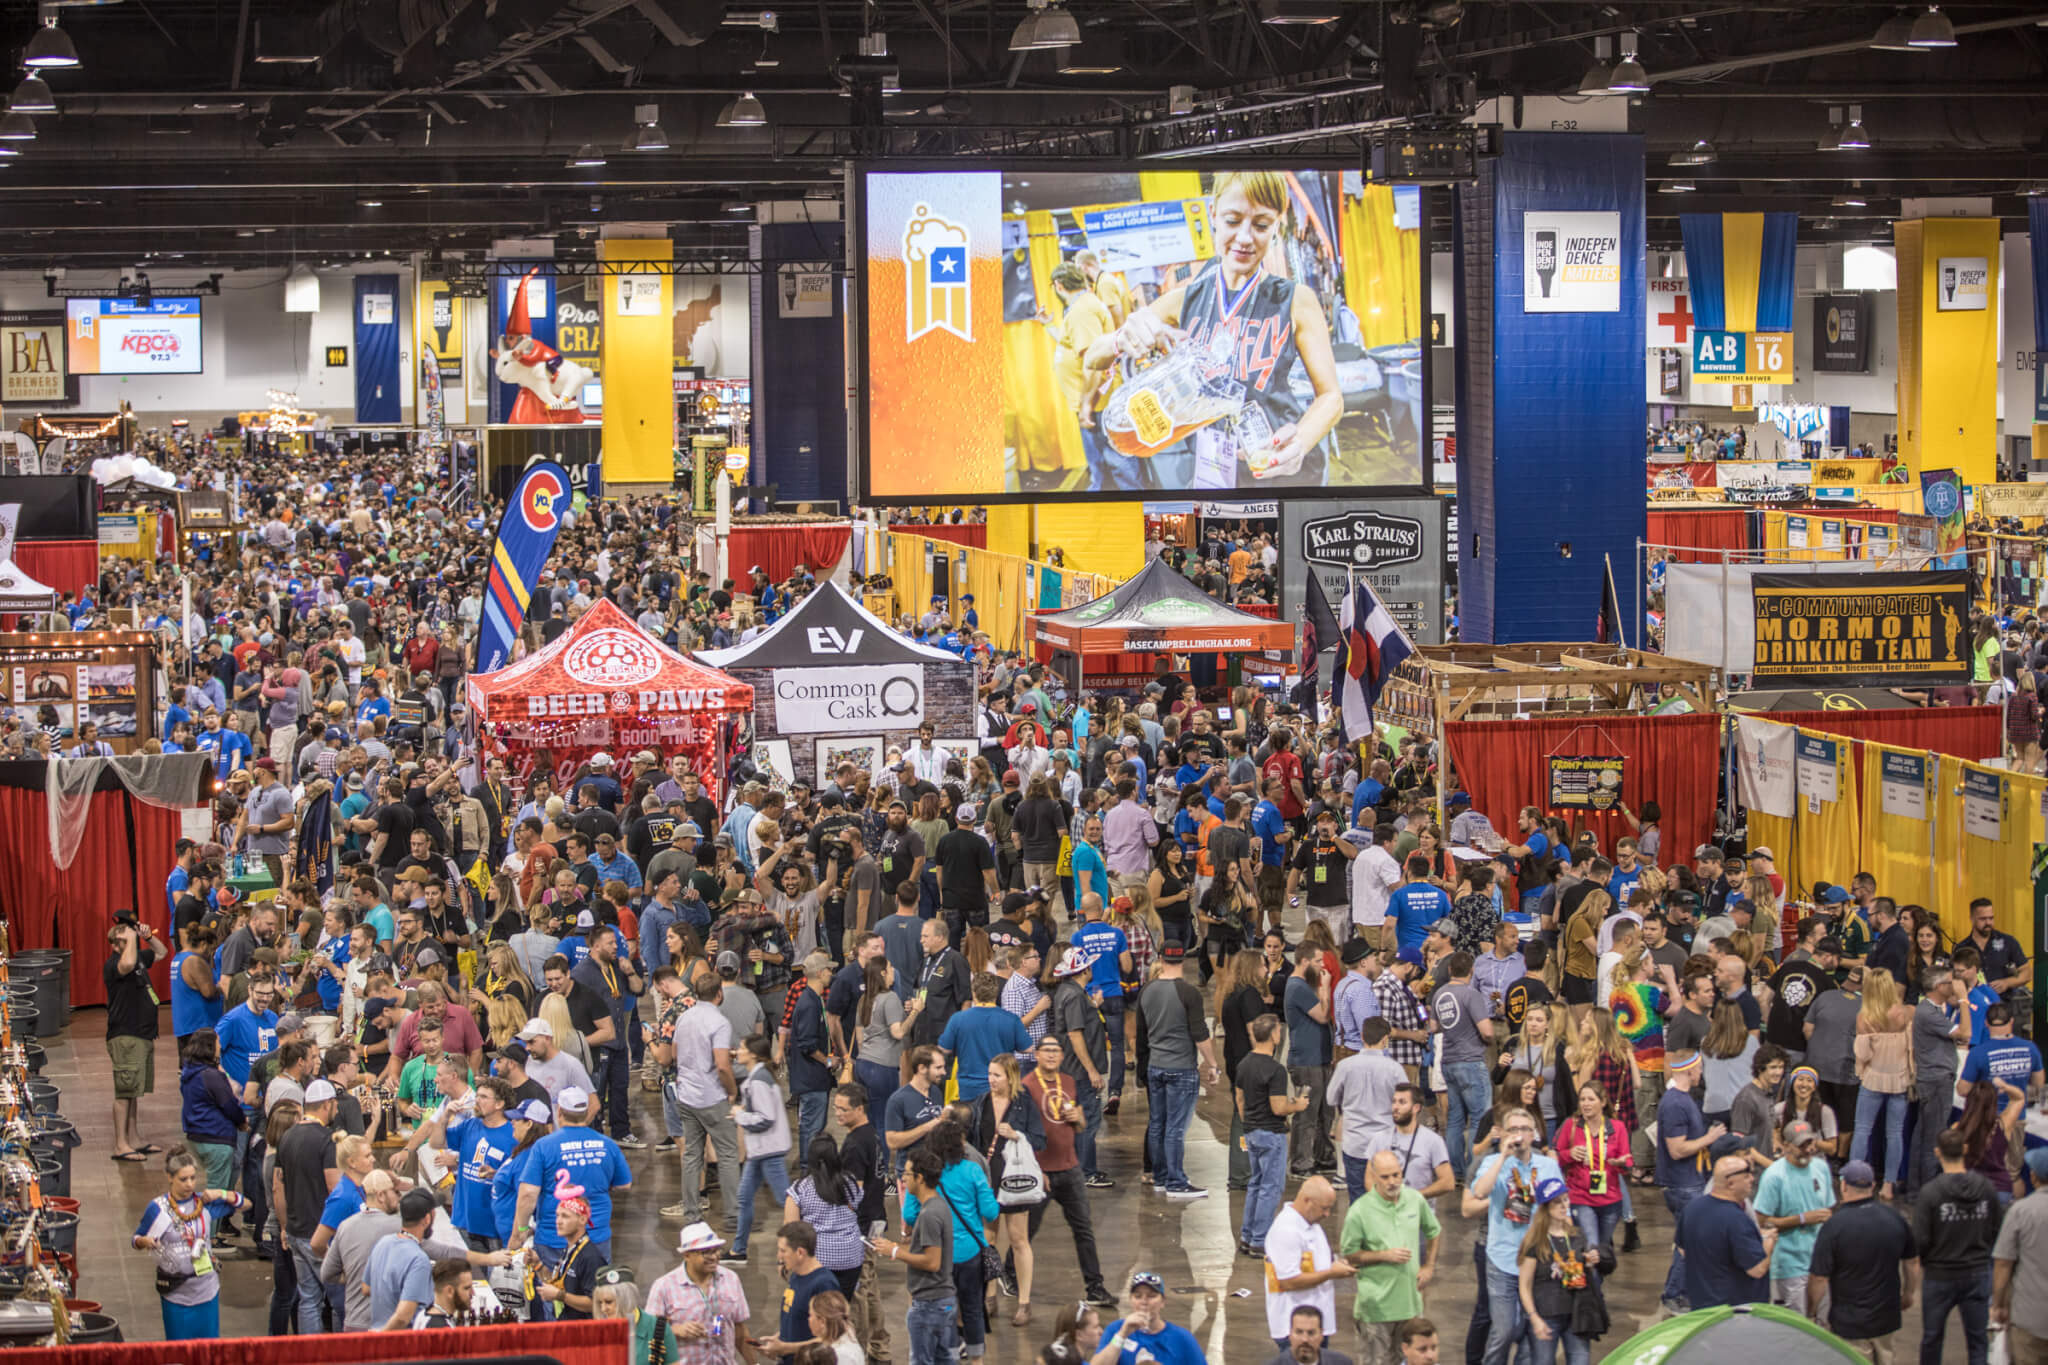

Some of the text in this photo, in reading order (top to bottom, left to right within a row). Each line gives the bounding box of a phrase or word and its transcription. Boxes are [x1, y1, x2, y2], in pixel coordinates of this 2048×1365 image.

[1551, 121, 1577, 130] F-32
[1565, 238, 1617, 251] INDEPEN
[1565, 252, 1605, 265] DENCE
[1564, 266, 1618, 281] MATTERS
[1651, 281, 1684, 292] FIRST
[558, 303, 600, 325] Pro
[1699, 335, 1738, 361] A-B
[1755, 343, 1783, 371] 16
[8, 376, 59, 388] BREWERS
[1656, 490, 1697, 500] ATWATER
[1309, 520, 1416, 548] KARL STRAUSS
[1316, 547, 1410, 558] BREWING COMPANY
[1381, 574, 1401, 587] BEER
[1756, 594, 1932, 618] X-COMMUNICATED
[1756, 615, 1932, 641] MORMON
[806, 626, 864, 654] EV
[1123, 638, 1252, 651] BASECAMPBELLINGHAM.ORG
[1756, 638, 1932, 663] DRINKING TEAM
[1757, 662, 1931, 674] Apostate Apparel for the Discerning Beer Drinker
[777, 679, 877, 700] Common
[527, 687, 725, 717] BEER PAWS
[827, 700, 877, 720] Cask
[620, 731, 660, 746] GOOD
[560, 1141, 582, 1151] BREW
